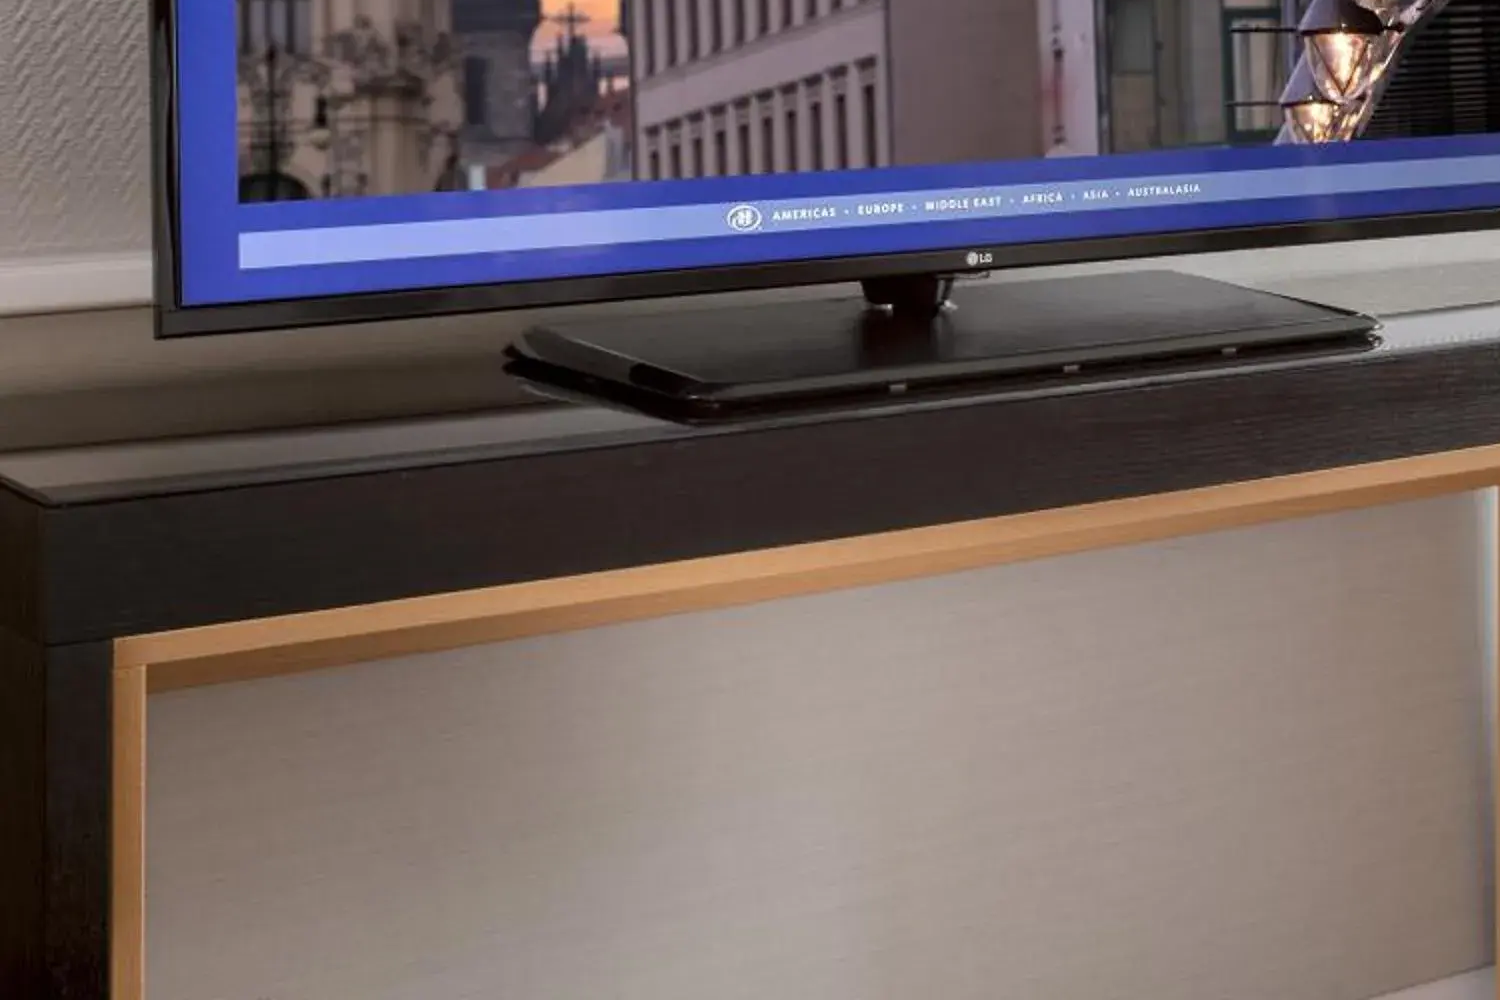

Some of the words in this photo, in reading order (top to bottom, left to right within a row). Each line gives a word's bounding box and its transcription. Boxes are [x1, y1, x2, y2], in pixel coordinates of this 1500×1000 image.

[771, 205, 837, 222] AMERICAS
[857, 203, 903, 216] EUROPE
[925, 198, 969, 211] MIDDLE
[973, 196, 1002, 207] EAST
[1023, 191, 1064, 204] AFRICA
[1083, 189, 1109, 201] ASIA
[1127, 183, 1201, 198] AUSTRALASIA
